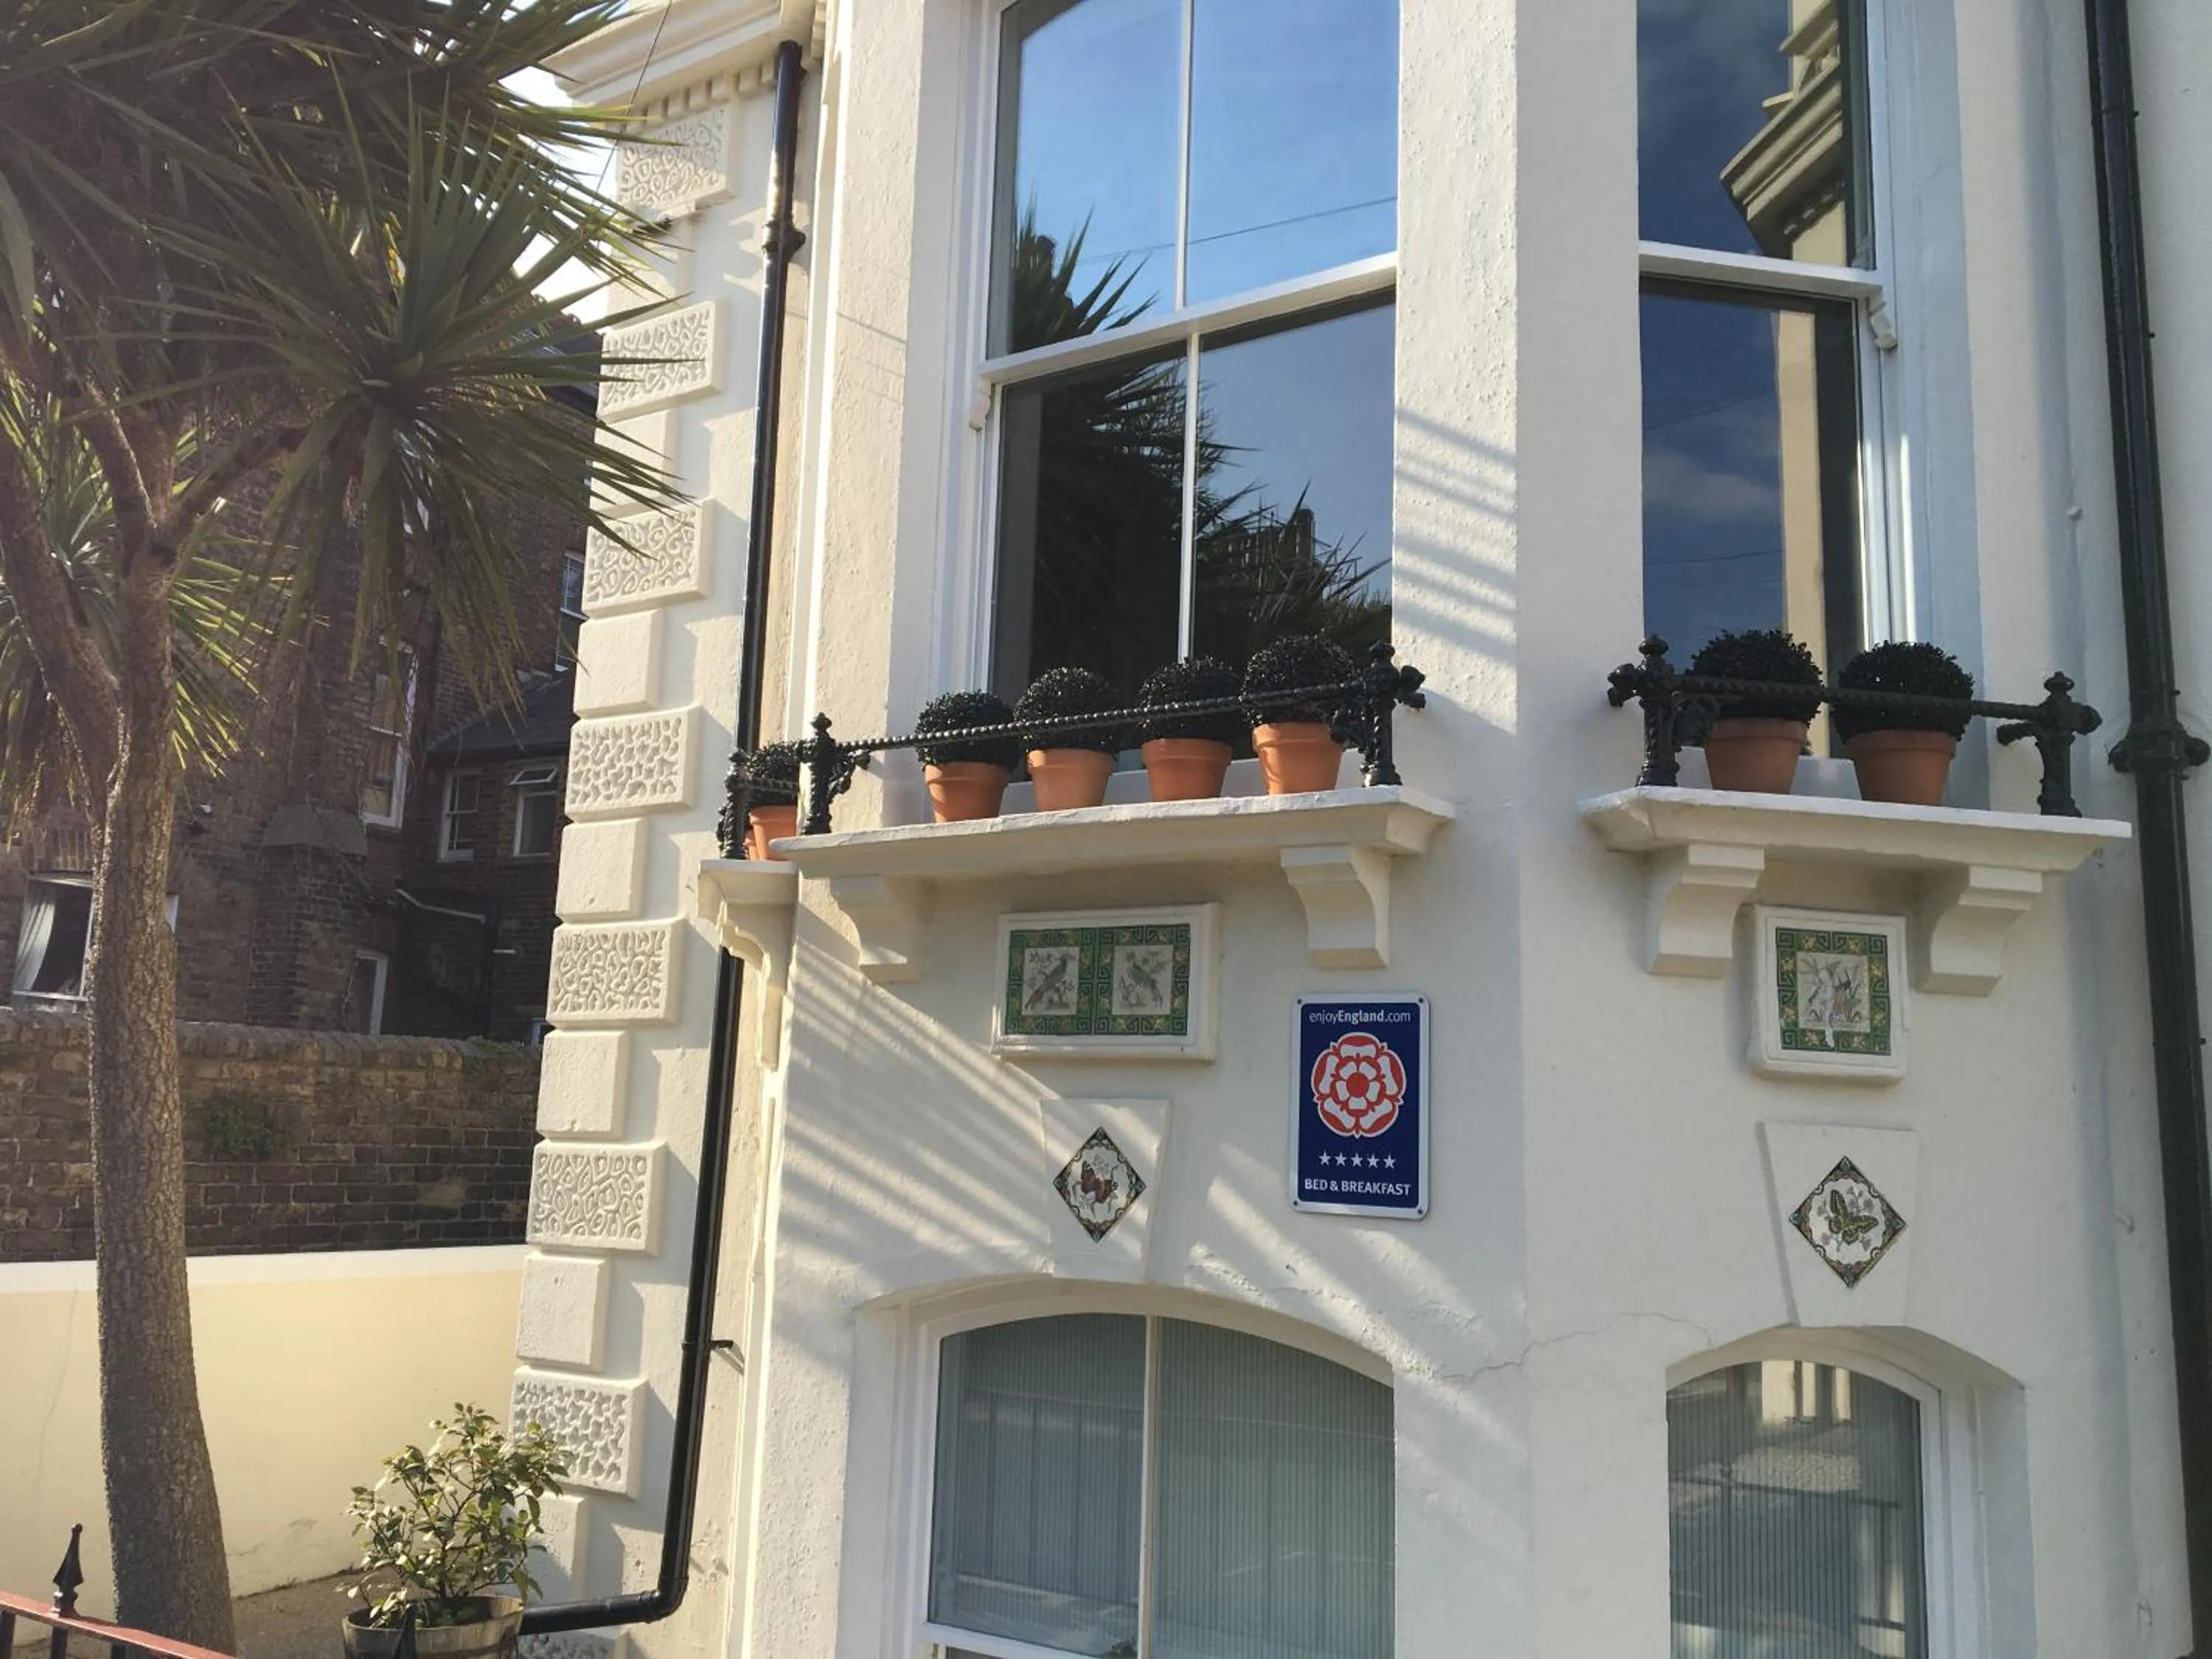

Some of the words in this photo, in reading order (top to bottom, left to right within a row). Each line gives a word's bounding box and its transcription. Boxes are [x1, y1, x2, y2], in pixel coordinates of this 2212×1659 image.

[1309, 1009, 1411, 1025] enjoyEngland.com
[1304, 1178, 1328, 1191] BED
[1329, 1180, 1339, 1192] &
[1341, 1180, 1412, 1196] BREAKFAST
